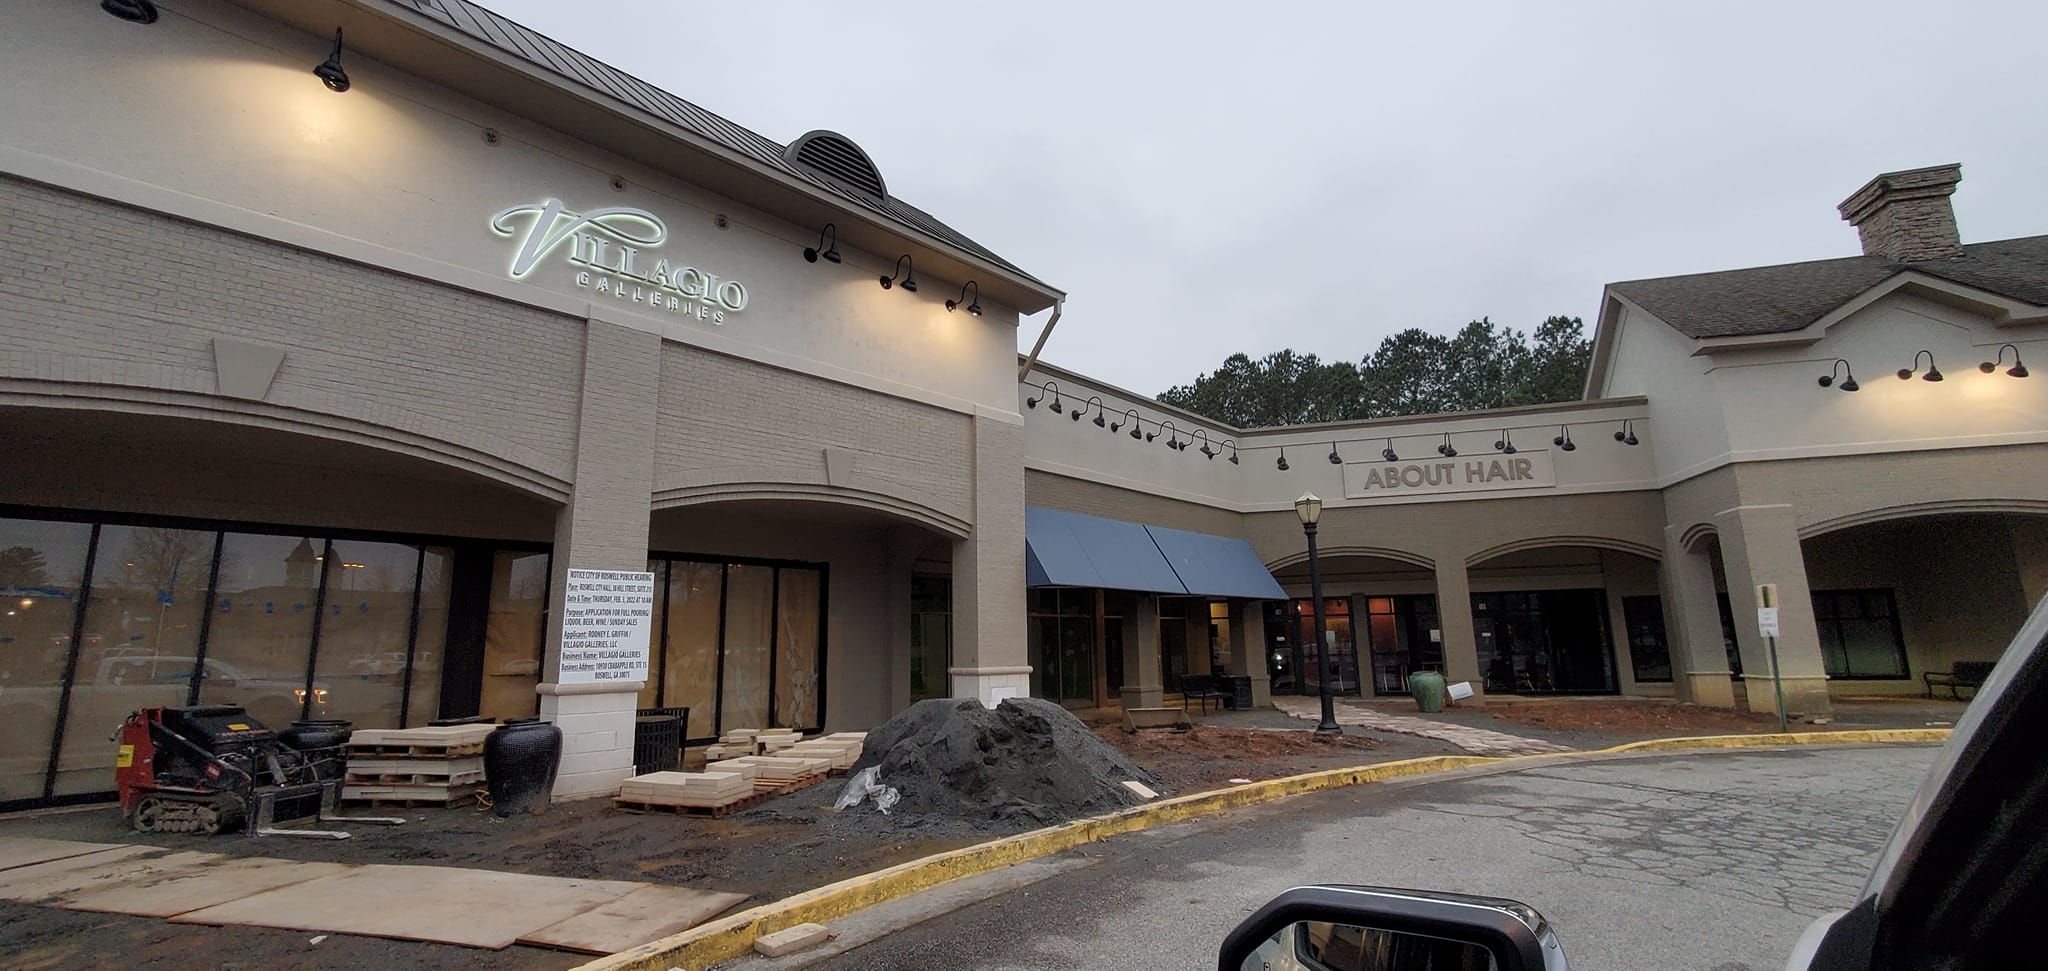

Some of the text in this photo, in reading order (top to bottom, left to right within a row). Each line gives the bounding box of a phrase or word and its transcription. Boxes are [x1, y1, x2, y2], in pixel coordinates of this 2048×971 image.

[490, 198, 749, 310] VILLAGIO
[577, 271, 727, 324] GALLERIES
[1363, 458, 1533, 490] ABOUT HAIR
[580, 583, 594, 591] ROSWELL
[566, 608, 584, 616] Purpose:
[564, 631, 587, 639] Applicant:
[588, 631, 606, 639] RODNEY
[562, 651, 641, 660] Business Name: VILLAGIO GALLERIES
